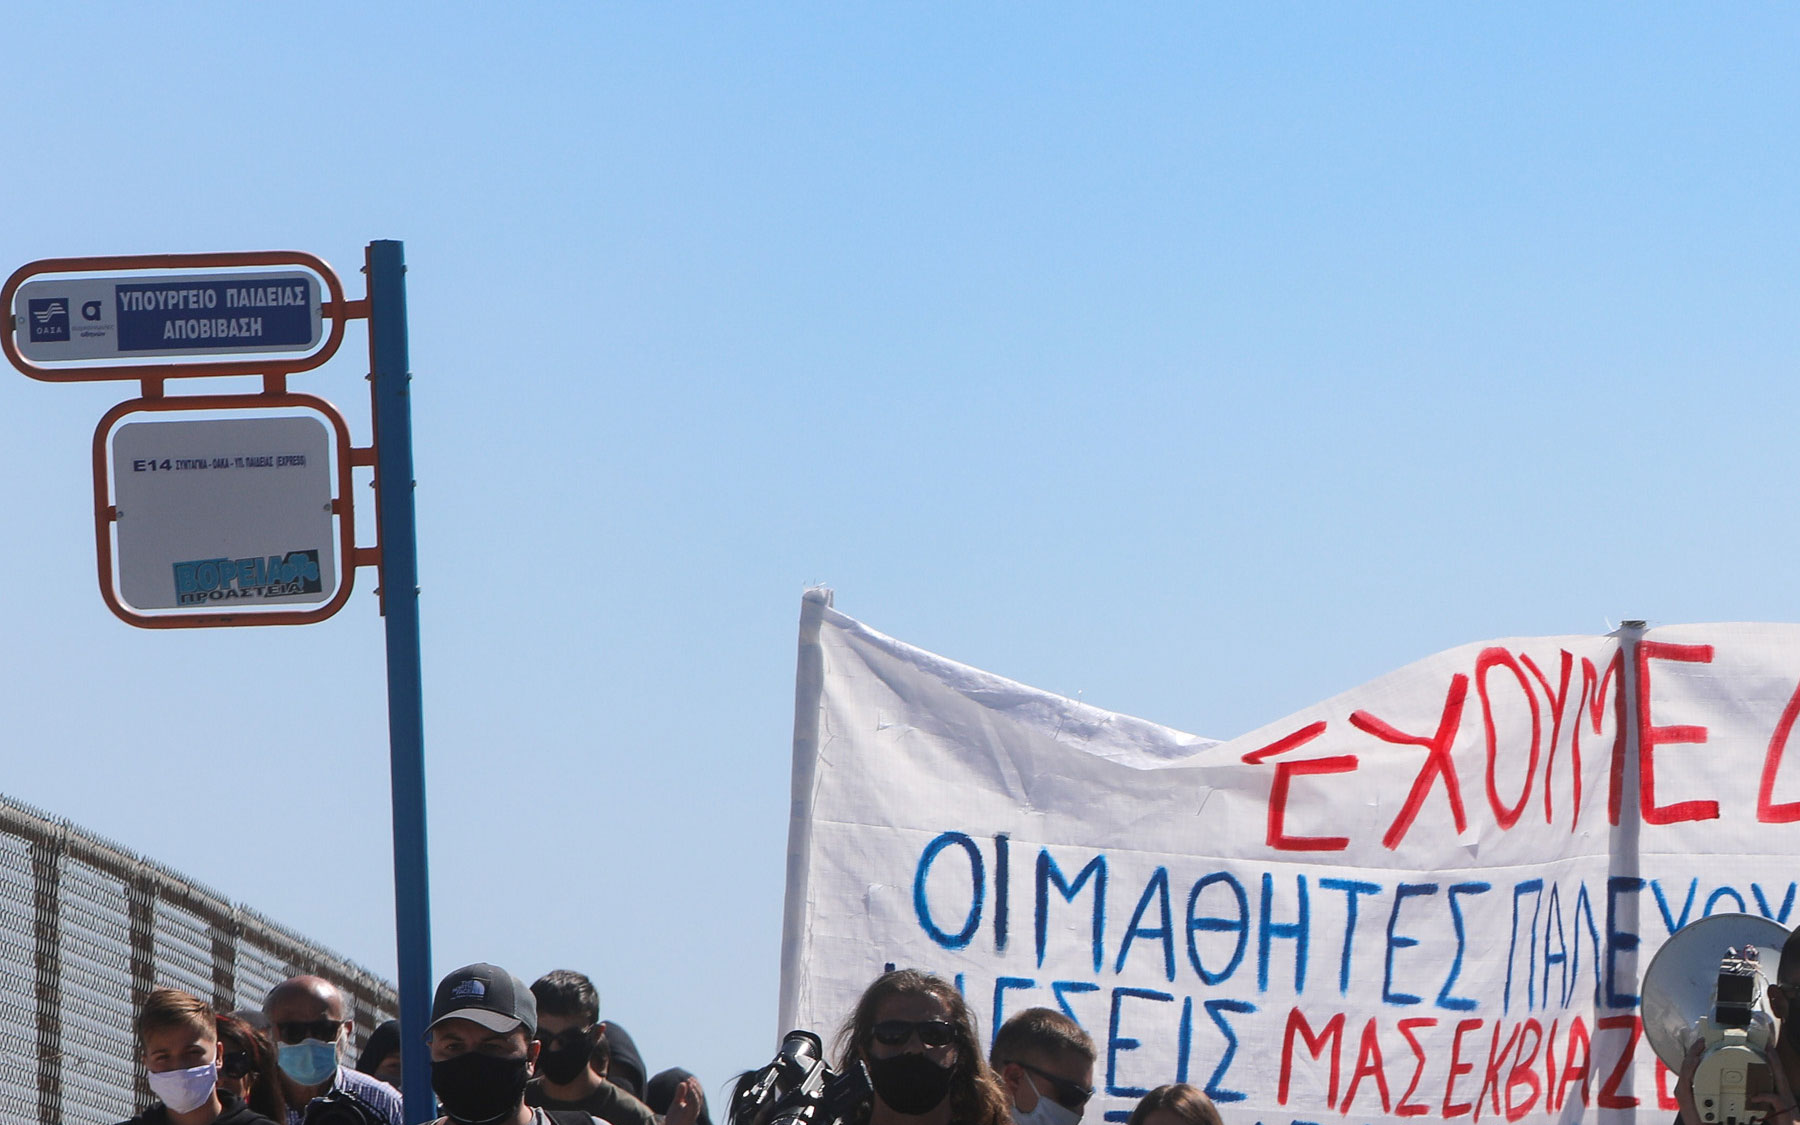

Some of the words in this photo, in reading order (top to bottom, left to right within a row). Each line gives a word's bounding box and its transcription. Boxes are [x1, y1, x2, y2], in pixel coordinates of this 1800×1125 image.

[120, 289, 217, 312] ΥΠΟΥΡΓΕΙΟ
[226, 286, 305, 308] ΠΑΙΔΕΙΑΣ
[163, 317, 263, 340] ΑΠΟΒΙΒΑΣΗ
[133, 459, 172, 472] E14
[175, 556, 288, 595] ΒΟΡΕΙΑ
[181, 582, 305, 604] ΠΡΟΑΣΤΕΙΑ
[914, 831, 1010, 953] ΟΙ
[1035, 847, 1492, 1013] ΜΑΘΗΤΕΣ
